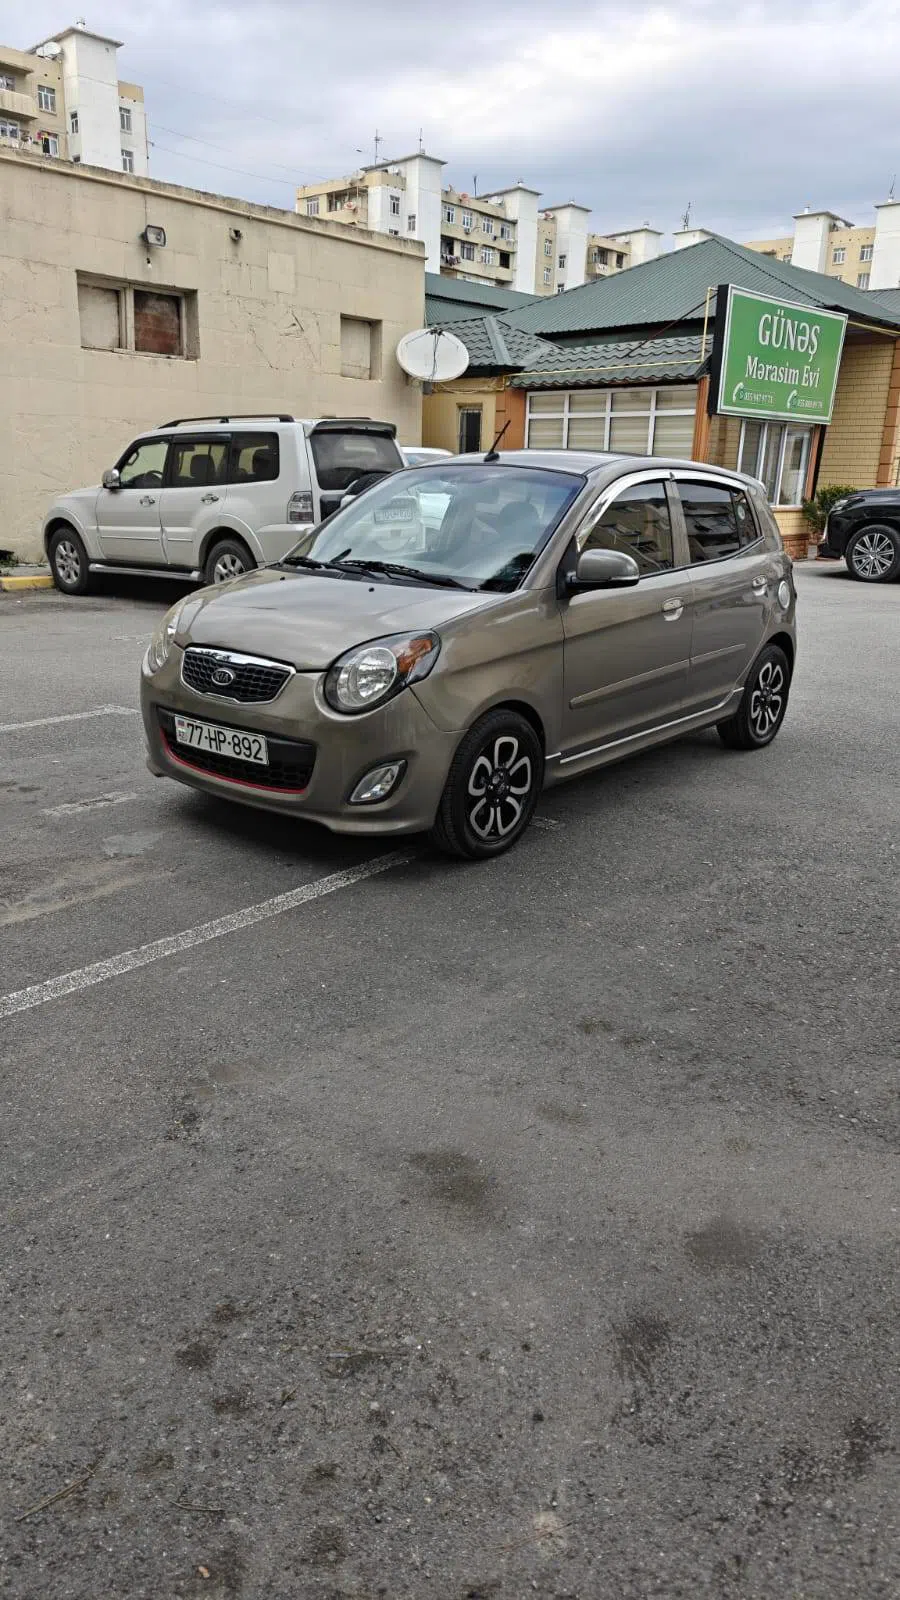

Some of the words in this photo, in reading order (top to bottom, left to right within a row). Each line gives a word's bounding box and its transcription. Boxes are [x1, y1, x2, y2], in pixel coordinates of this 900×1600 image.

[758, 309, 820, 362] GÜNƏŞ
[745, 355, 799, 385] Mərasim
[801, 365, 820, 388] Evi
[214, 671, 229, 682] KIA
